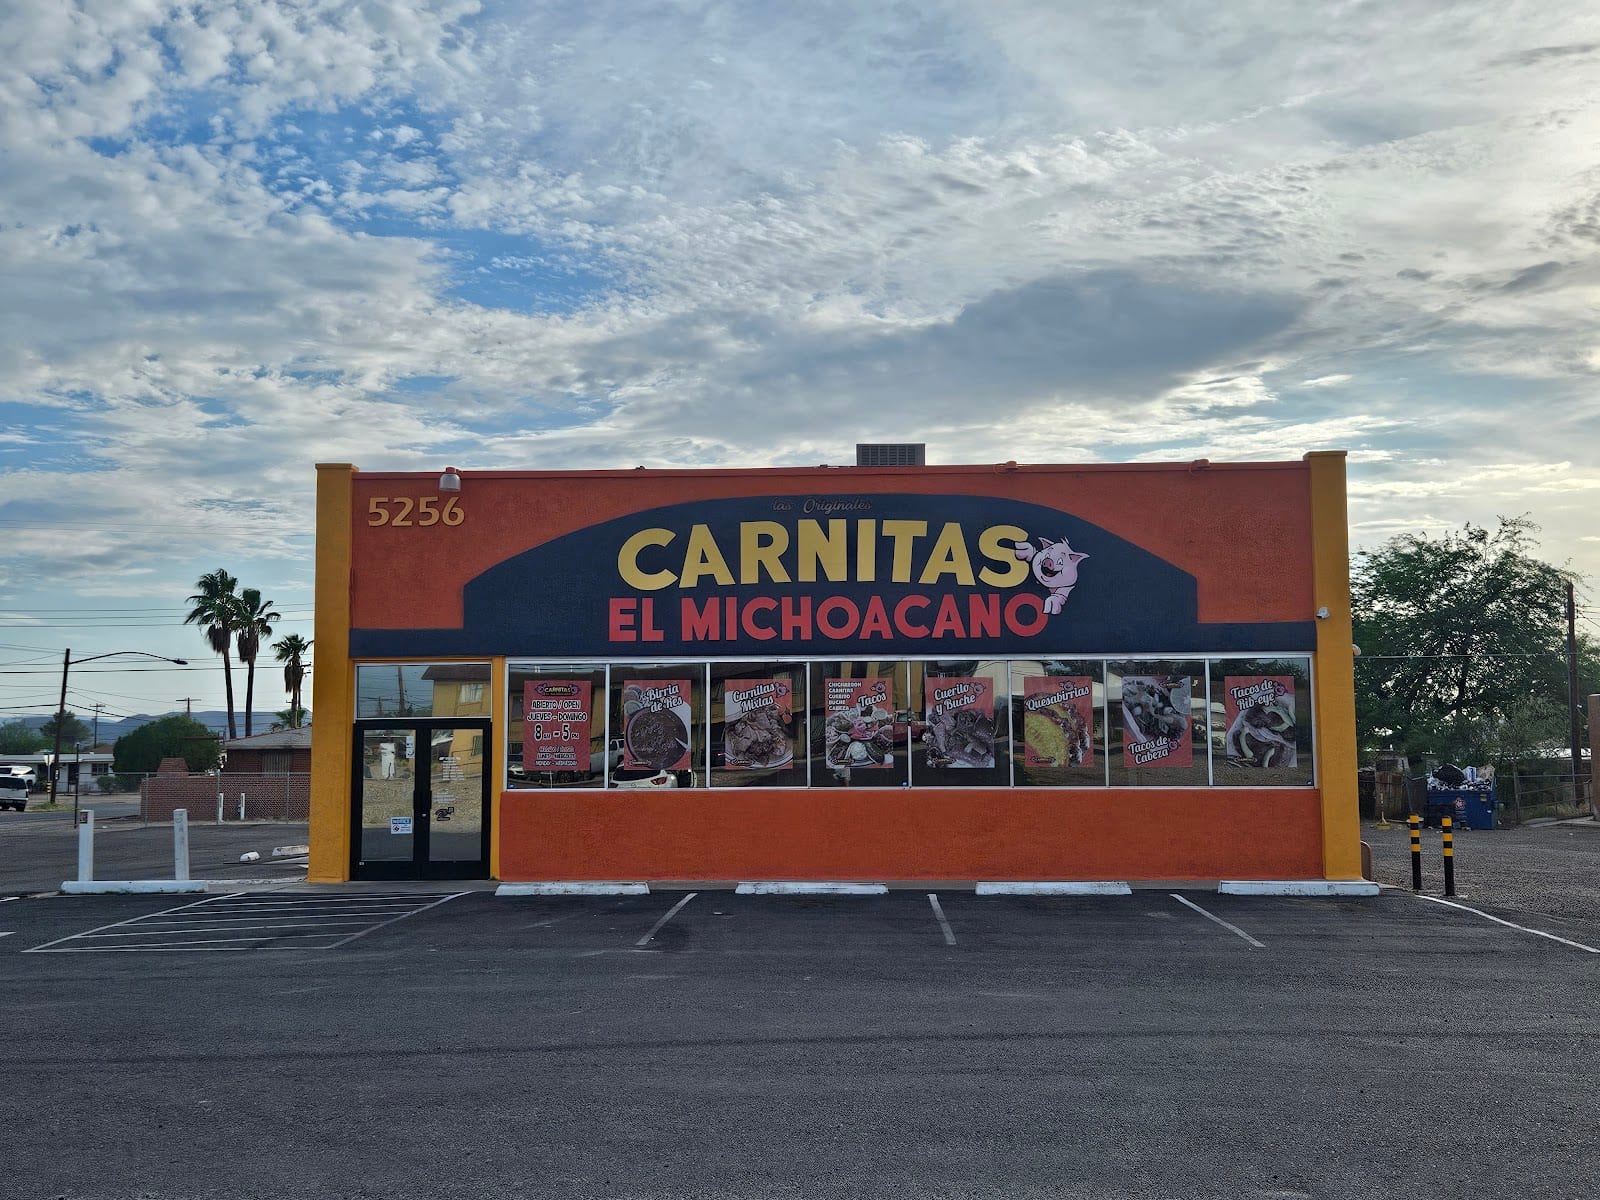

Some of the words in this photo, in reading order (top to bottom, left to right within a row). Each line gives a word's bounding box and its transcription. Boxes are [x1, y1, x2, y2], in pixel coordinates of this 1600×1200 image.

[368, 496, 465, 526] 5256
[803, 498, 873, 515] Originales
[617, 519, 1030, 591] CARNITAS
[608, 597, 665, 642] EL
[681, 593, 1049, 641] MICHOACANO
[646, 683, 679, 702] Birria
[732, 682, 775, 703] Carnitas
[933, 683, 970, 701] Cuerito
[1025, 685, 1091, 712] Quesabirrias
[1231, 683, 1260, 700] Tacos
[1260, 679, 1274, 693] de
[531, 700, 557, 709] ABIERTO
[563, 700, 581, 709] OPEN
[650, 698, 665, 713] de
[665, 694, 683, 710] Res
[739, 695, 774, 713] Mixtas
[857, 692, 887, 707] Tacos
[936, 704, 943, 716] y
[944, 694, 976, 710] Buche
[1236, 692, 1275, 711] Rib-eye
[527, 712, 552, 721] JUEVES
[558, 712, 587, 721] DOMINGO
[535, 723, 542, 741] 8
[562, 723, 570, 741] 5
[1128, 738, 1154, 754] Tacos
[1154, 736, 1168, 750] de
[1134, 747, 1169, 765] Cabeza
